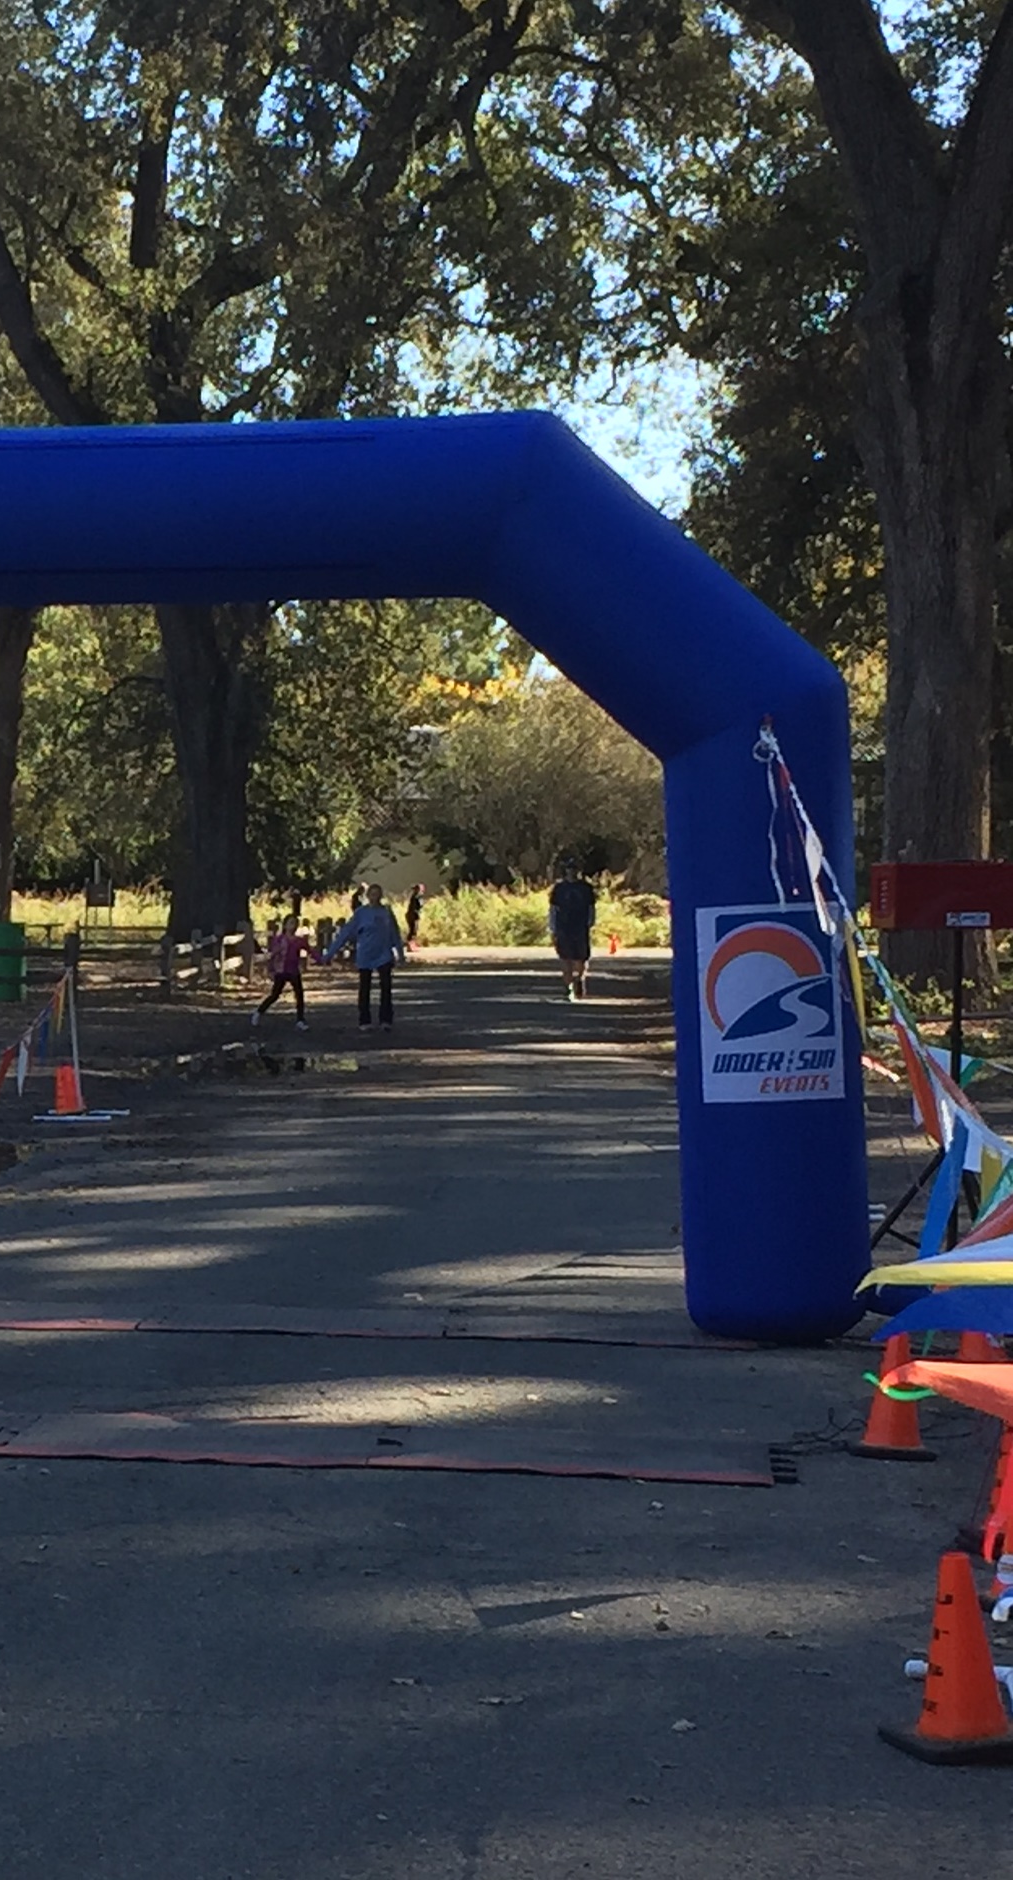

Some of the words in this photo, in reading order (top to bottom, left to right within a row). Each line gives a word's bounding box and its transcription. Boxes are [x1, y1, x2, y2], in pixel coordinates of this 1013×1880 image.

[712, 1051, 785, 1074] UNDER
[795, 1048, 836, 1071] SUN
[759, 1074, 830, 1094] EVENTS
